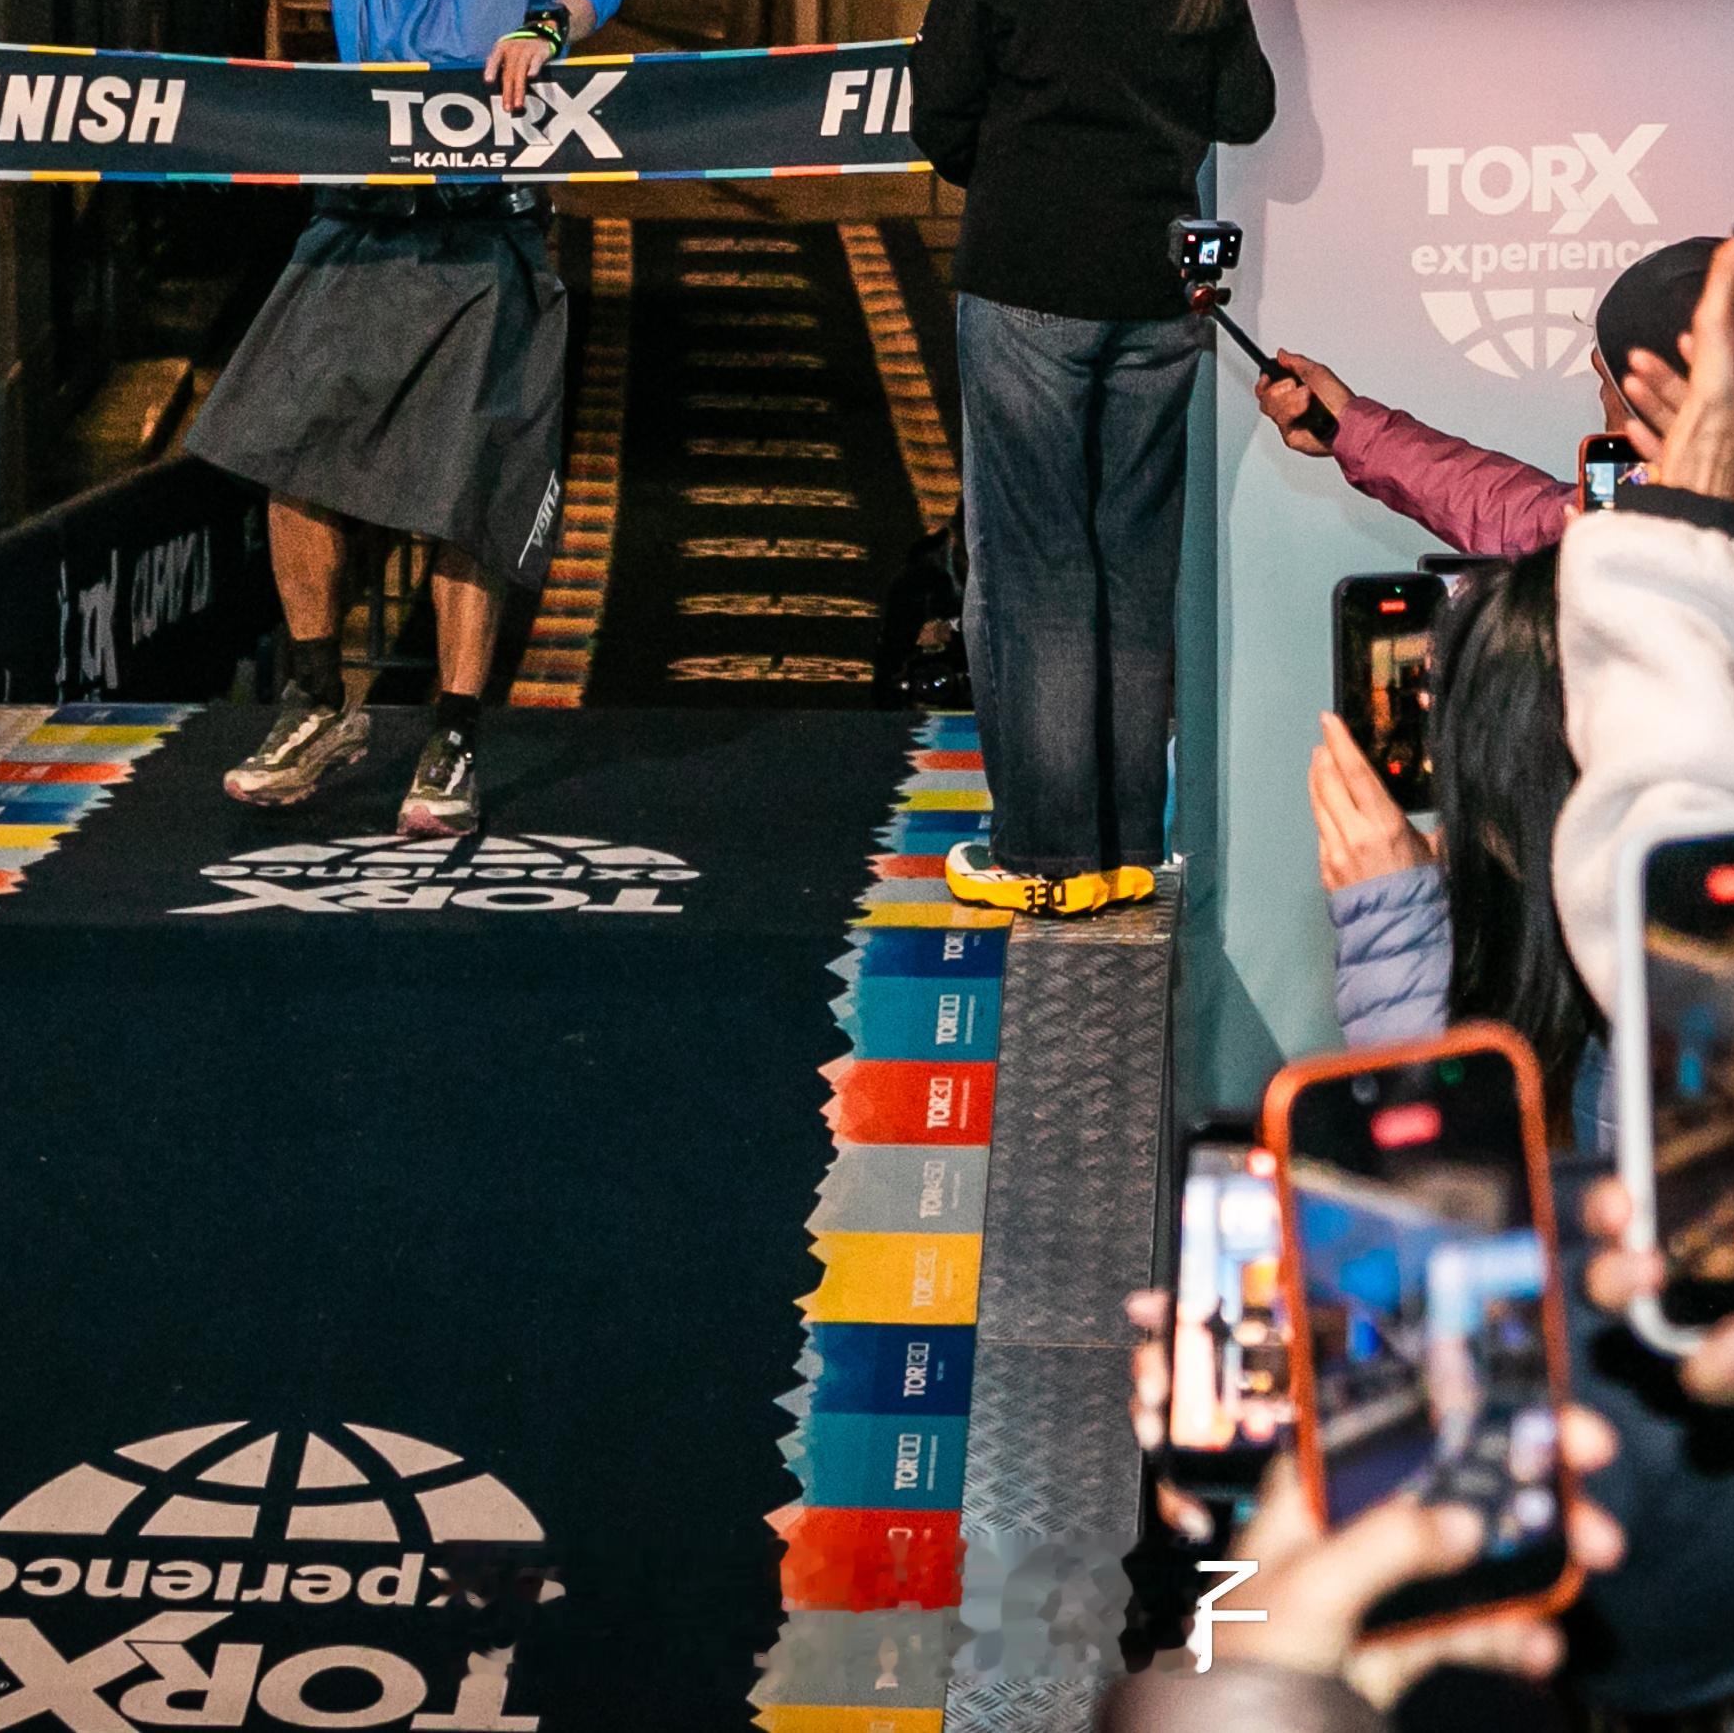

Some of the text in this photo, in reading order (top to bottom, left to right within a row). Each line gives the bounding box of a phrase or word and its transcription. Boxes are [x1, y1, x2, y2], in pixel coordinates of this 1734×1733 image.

[371, 71, 628, 168] TORX
[413, 151, 507, 168] KAILAS
[1411, 123, 1670, 235] TORX
[198, 863, 702, 882] experience
[166, 878, 684, 914] TORX
